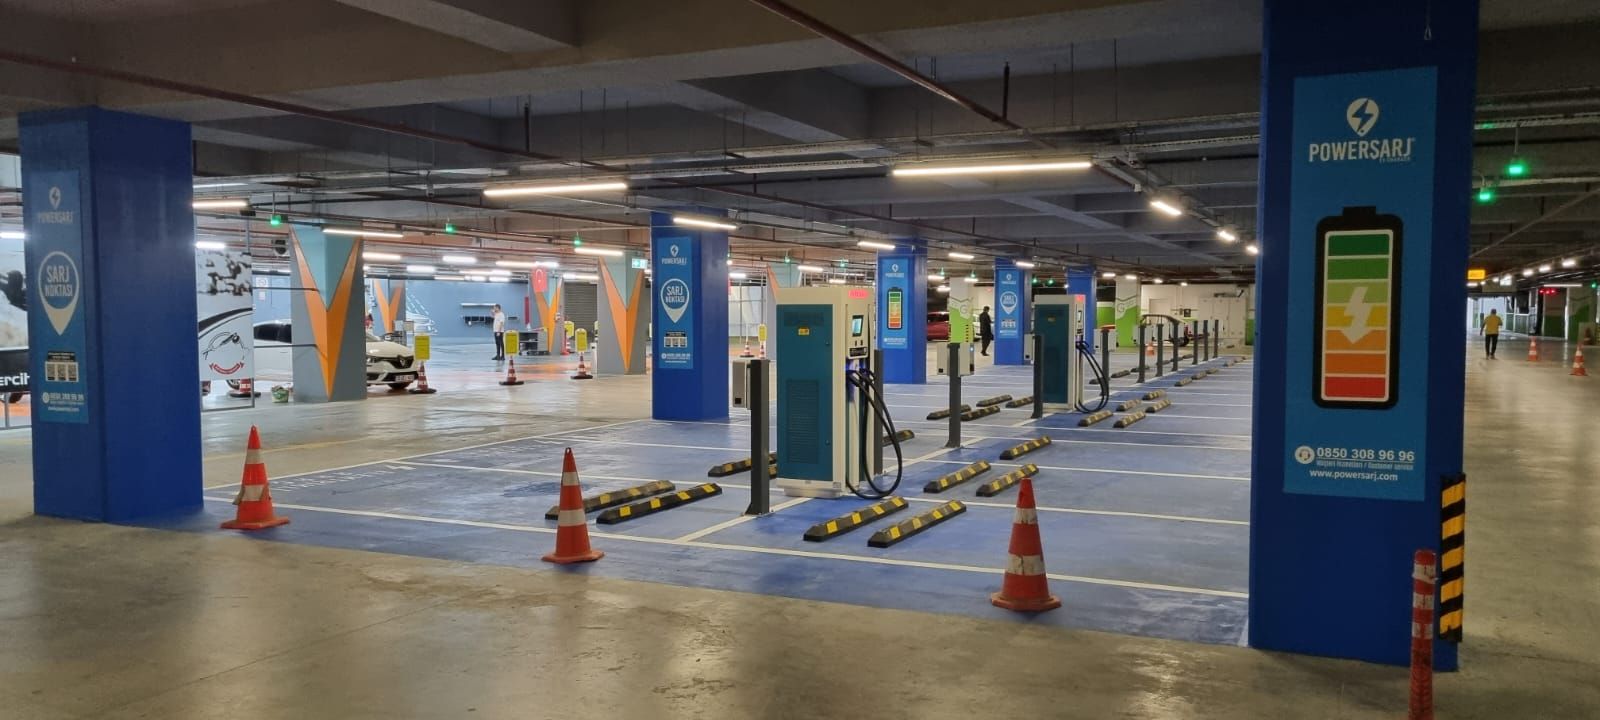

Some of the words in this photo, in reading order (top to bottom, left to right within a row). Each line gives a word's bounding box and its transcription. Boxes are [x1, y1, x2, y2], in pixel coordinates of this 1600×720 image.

[1308, 138, 1411, 162] POWERSARJ
[1316, 447, 1348, 458] 0850
[1351, 449, 1375, 460] 308
[1378, 450, 1395, 461] 96
[1398, 451, 1415, 462] 96
[1309, 470, 1398, 481] www.powersarj.com
